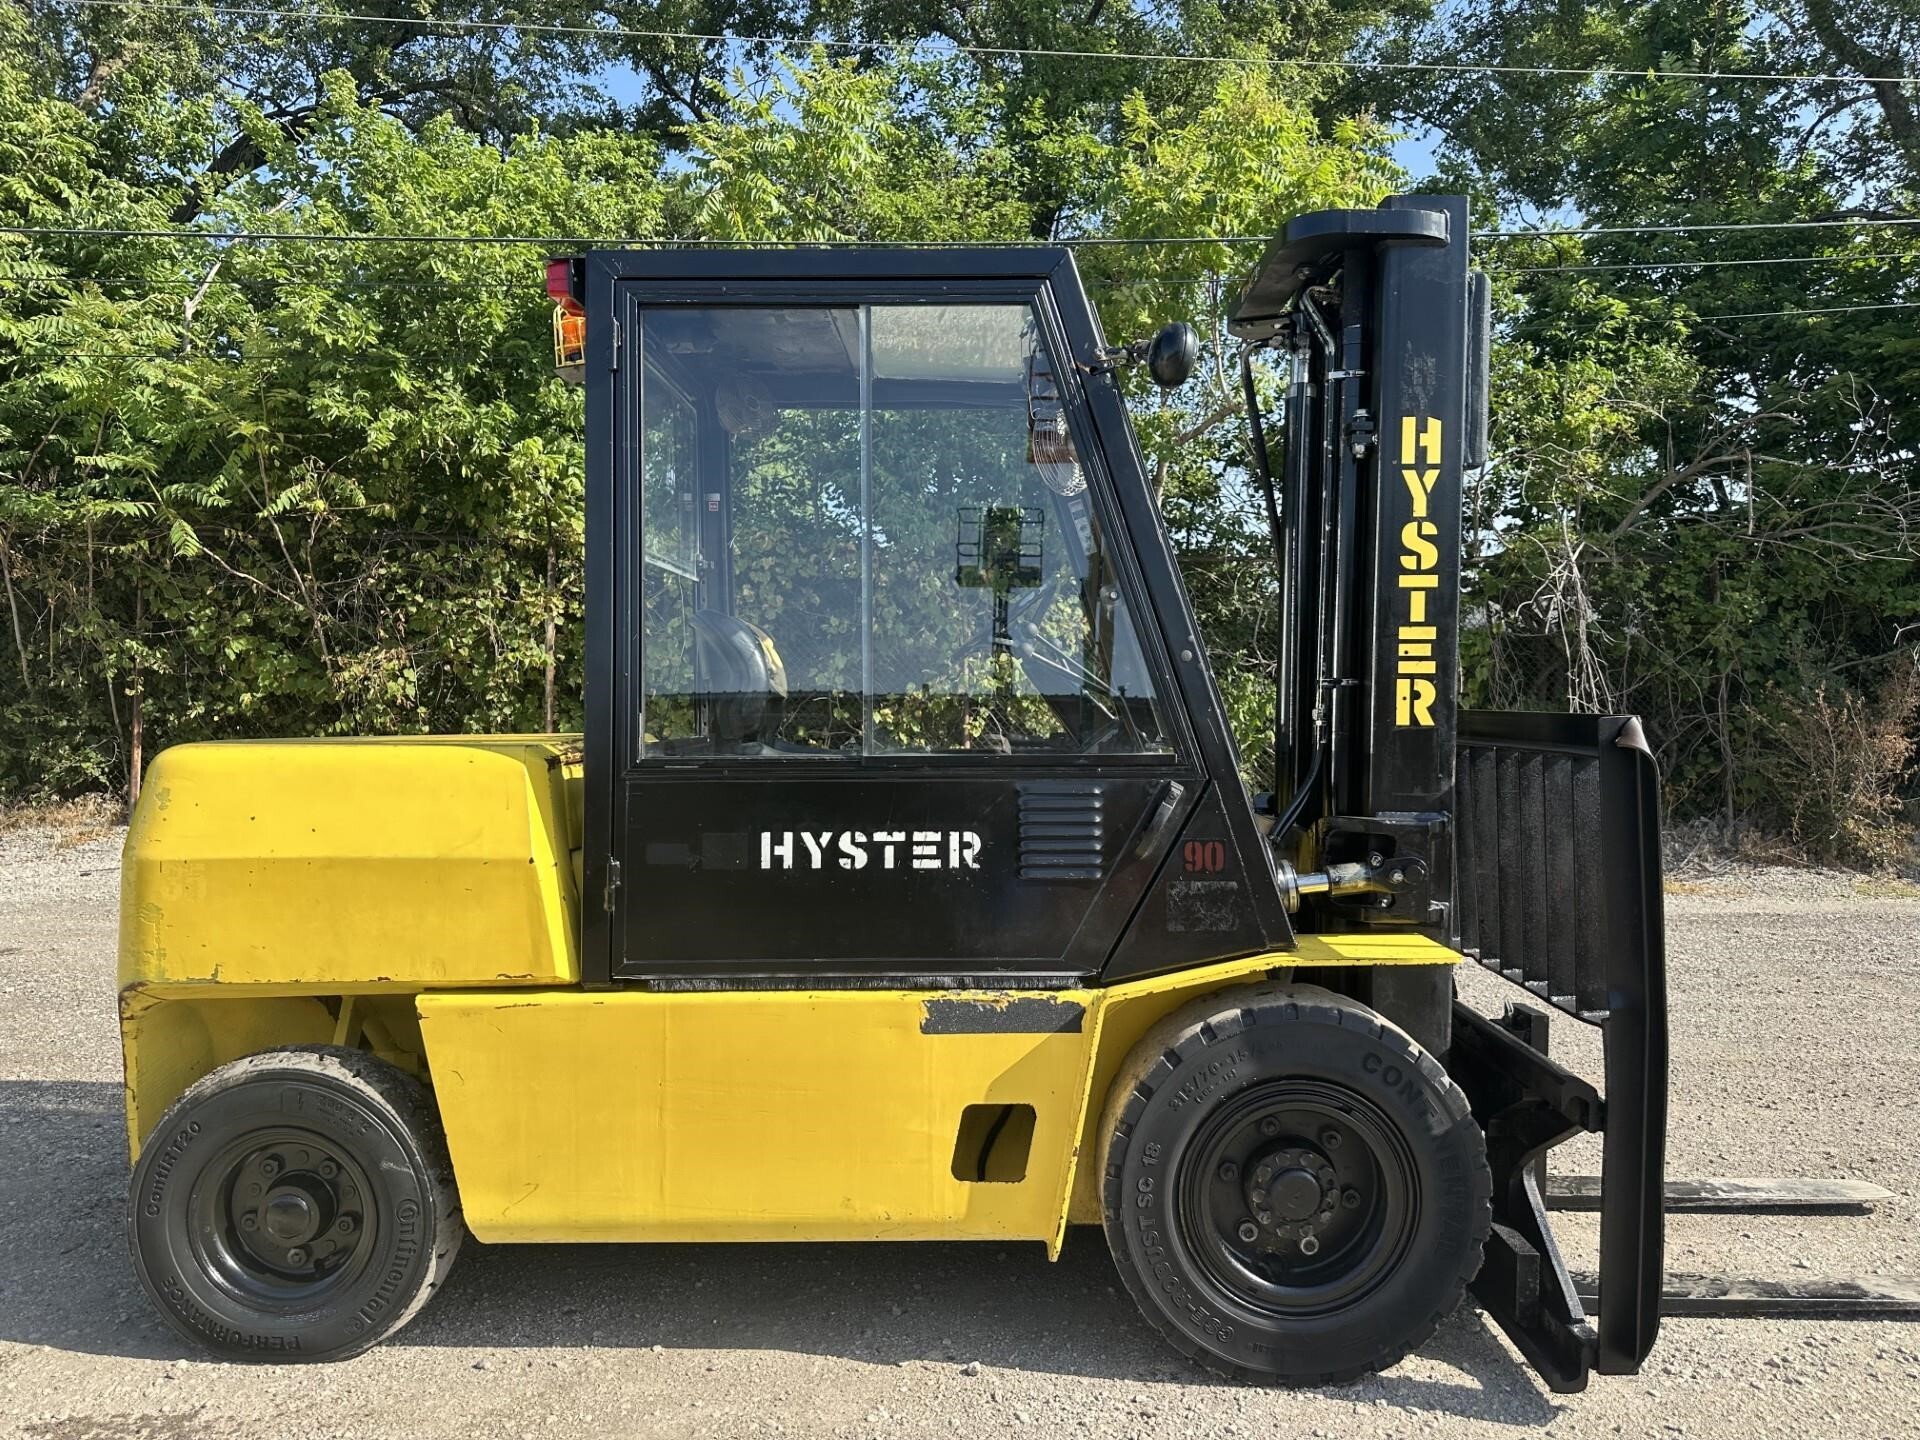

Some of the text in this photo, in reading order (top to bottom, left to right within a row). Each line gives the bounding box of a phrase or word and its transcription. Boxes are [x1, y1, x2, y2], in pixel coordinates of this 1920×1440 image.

[1395, 416, 1442, 726] HYSTER
[761, 831, 981, 869] HYSTER
[1184, 841, 1225, 872] 90
